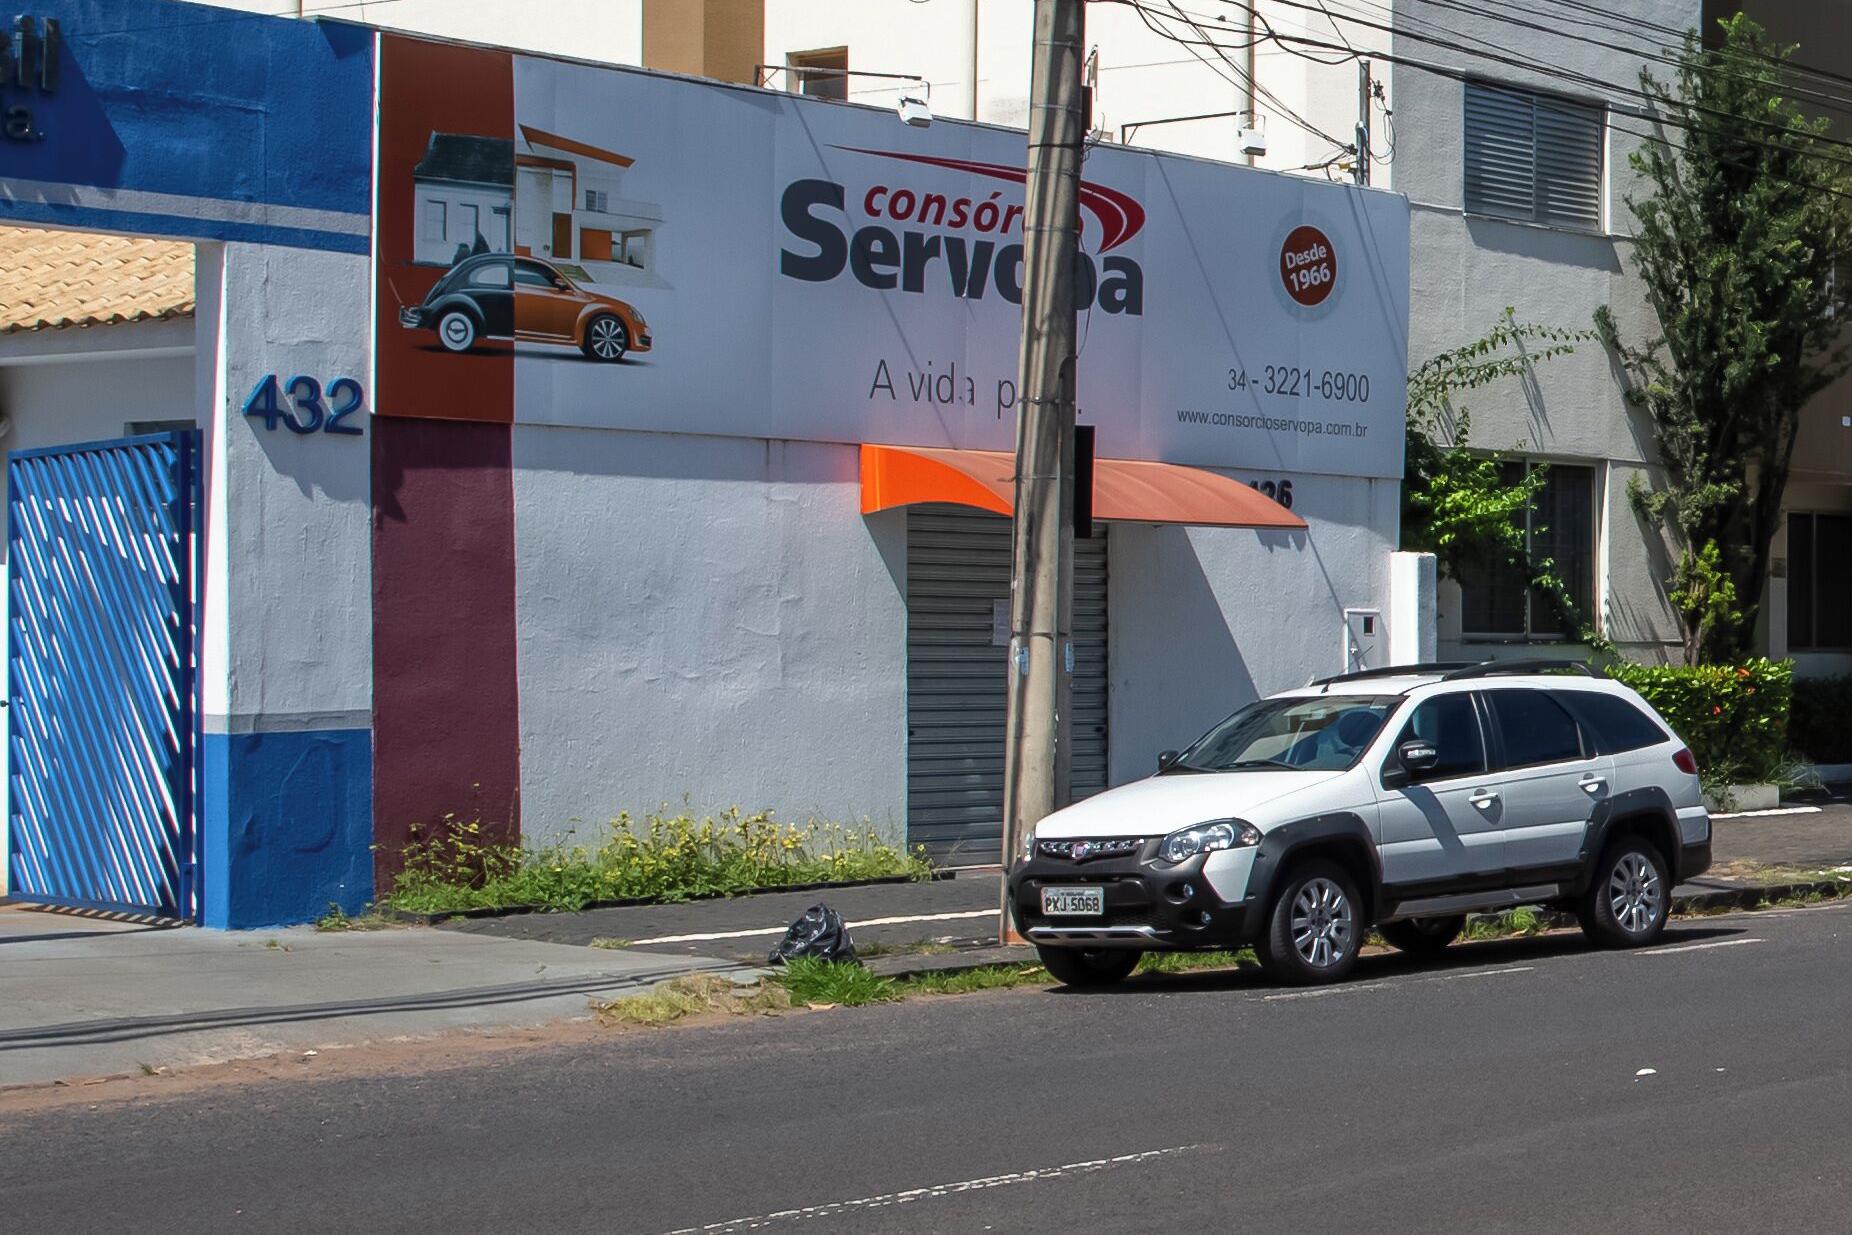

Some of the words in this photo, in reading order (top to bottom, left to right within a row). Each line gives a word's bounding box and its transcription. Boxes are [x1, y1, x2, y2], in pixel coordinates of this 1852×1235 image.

[1284, 243, 1327, 270] Desde
[1289, 262, 1331, 293] 1966
[869, 358, 896, 400] A
[1228, 368, 1247, 392] 34
[1264, 365, 1370, 403] 3221-6900
[241, 374, 364, 436] 432
[1177, 408, 1368, 438] www.consorcioservopa.com.br
